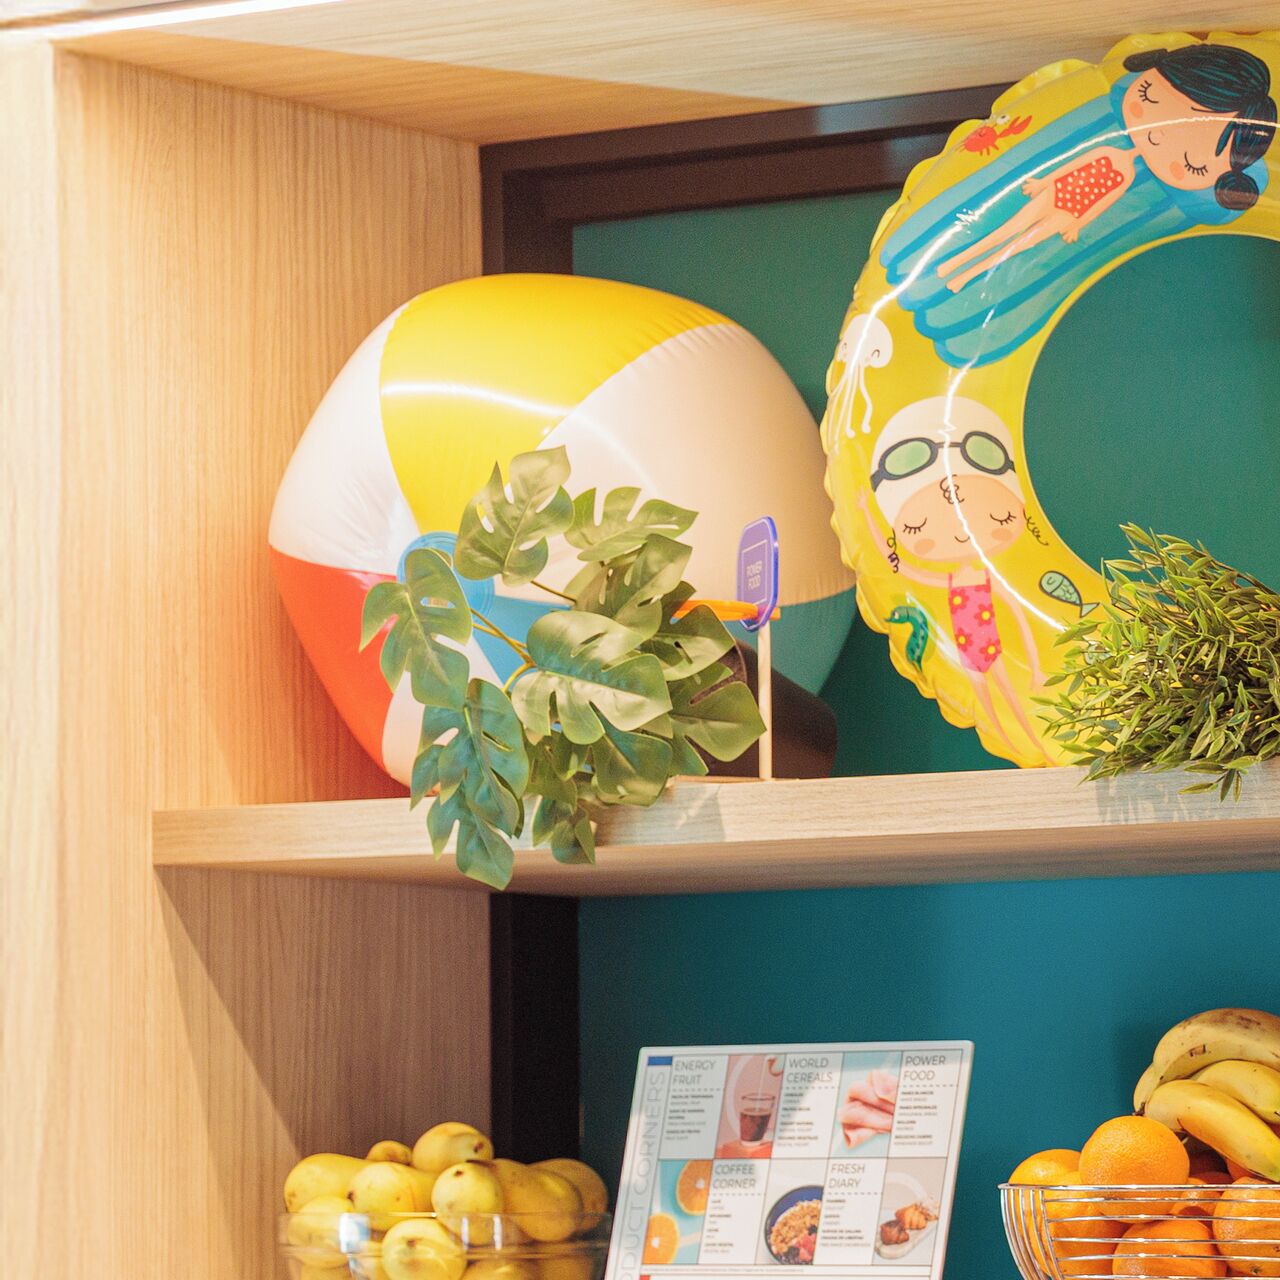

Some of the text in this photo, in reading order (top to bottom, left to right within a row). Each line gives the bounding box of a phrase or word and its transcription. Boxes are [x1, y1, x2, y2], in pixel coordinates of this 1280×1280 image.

[674, 1060, 716, 1070] ENERGY
[789, 1057, 829, 1068] WORLD
[905, 1055, 946, 1066] POWER
[673, 1075, 702, 1084] FRUIT
[786, 1072, 832, 1083] CEREALS
[904, 1071, 935, 1080] FOOD
[633, 1071, 664, 1195] CORNERS
[715, 1164, 755, 1175] COFFEE
[831, 1164, 865, 1173] FRESH
[713, 1179, 756, 1189] CORNER
[829, 1179, 861, 1188] DIARY
